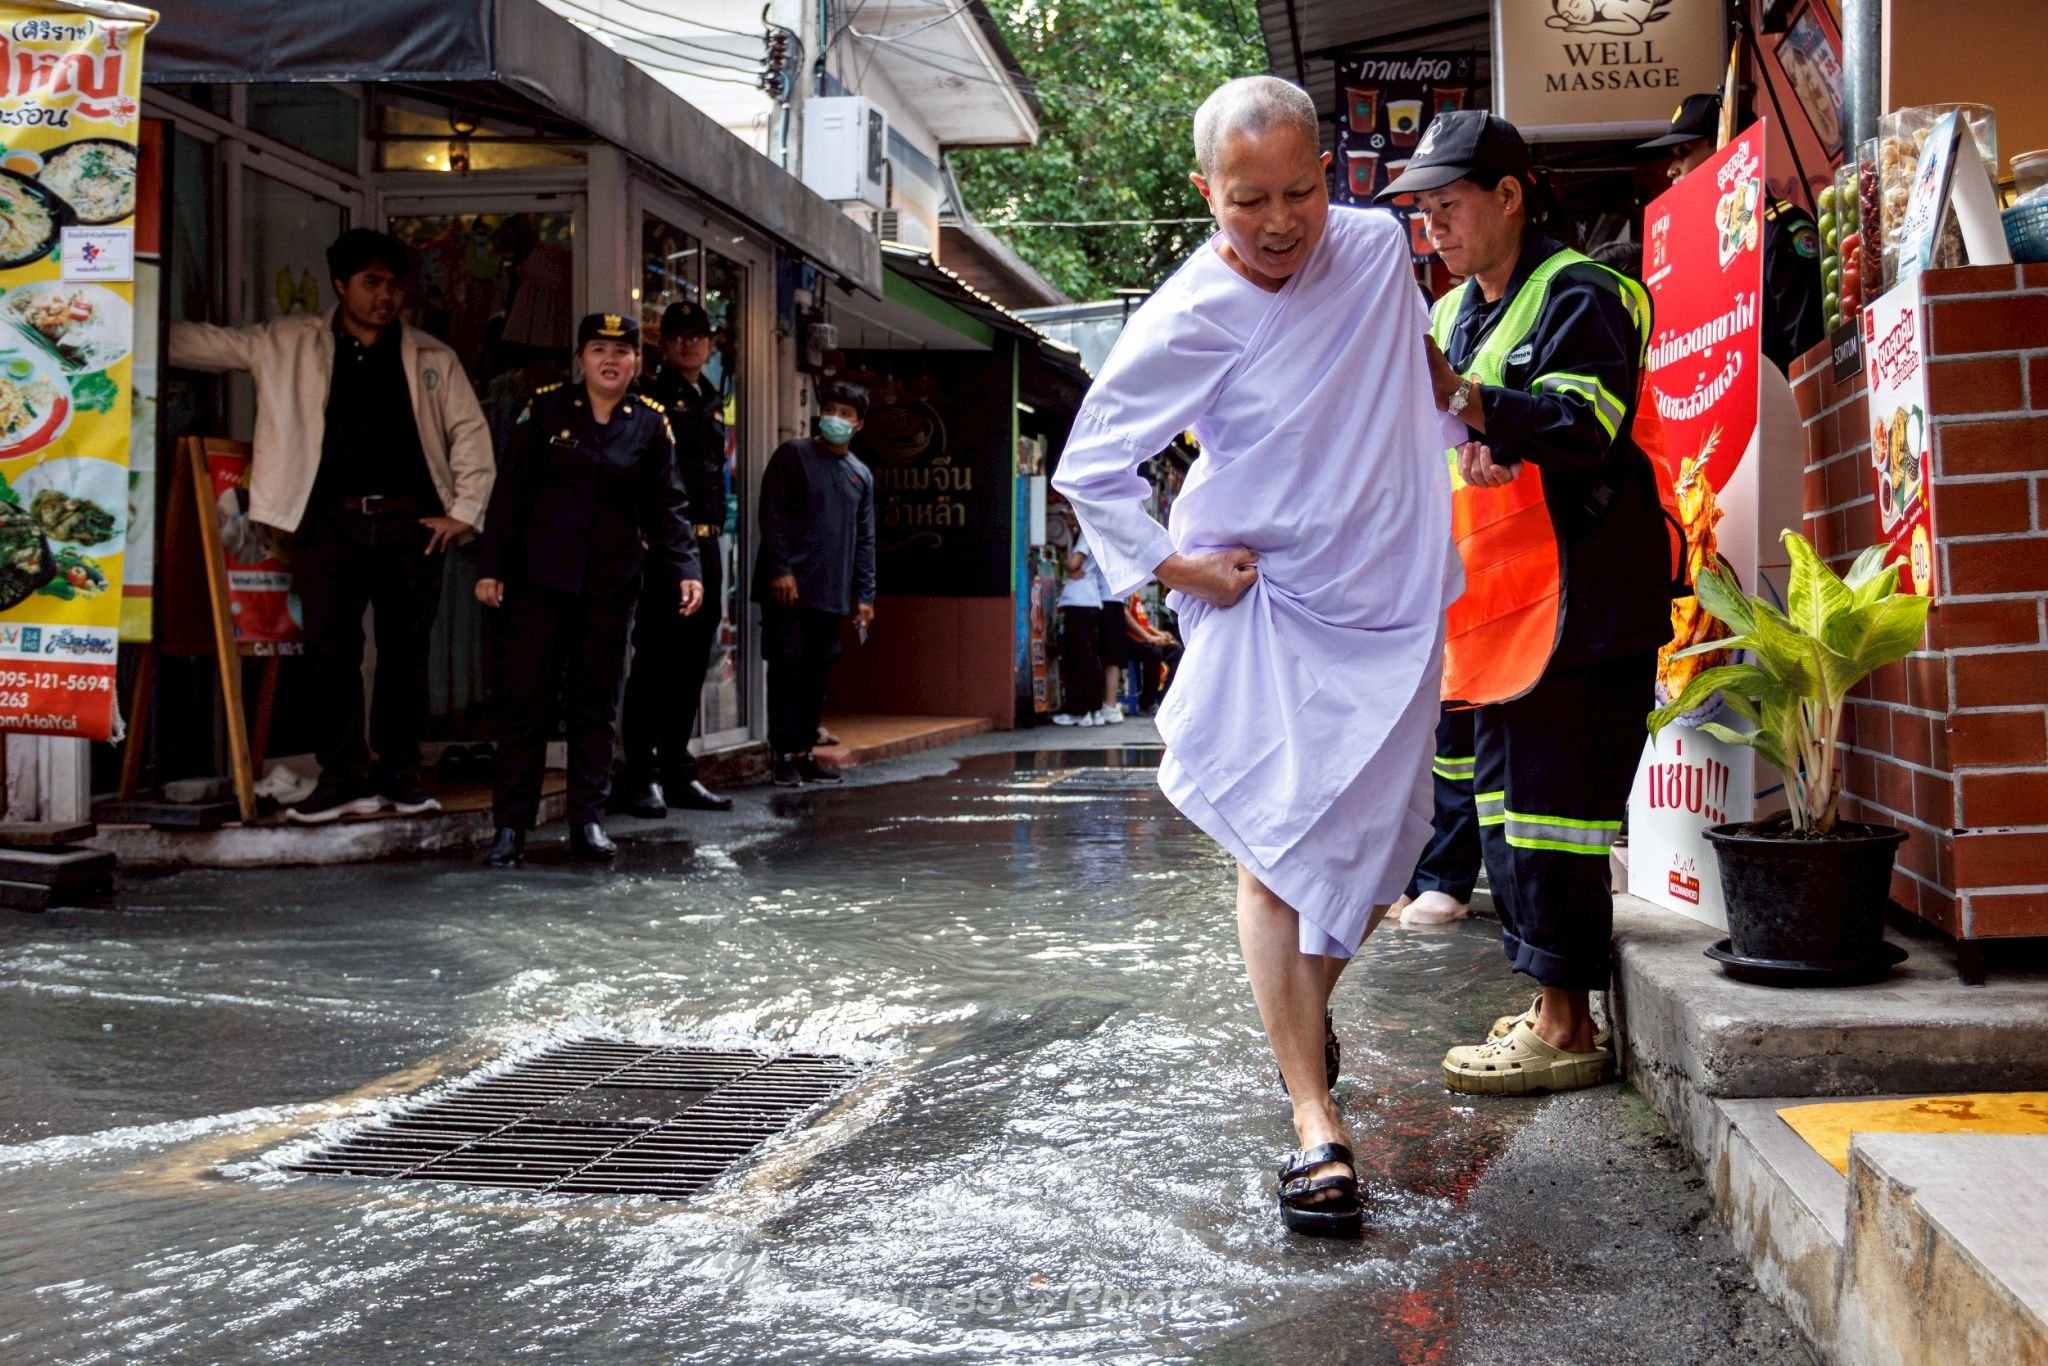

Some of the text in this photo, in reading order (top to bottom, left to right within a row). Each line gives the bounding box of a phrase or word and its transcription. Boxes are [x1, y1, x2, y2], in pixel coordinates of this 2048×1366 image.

[12, 20, 94, 41] (ศิริราช)
[1562, 40, 1663, 67] WELL
[1360, 57, 1451, 81] กาแฟสด
[1546, 68, 1680, 92] MASSAGE
[1834, 336, 1858, 366] SOMTUM
[1649, 738, 1729, 825] แซ่บ!!!
